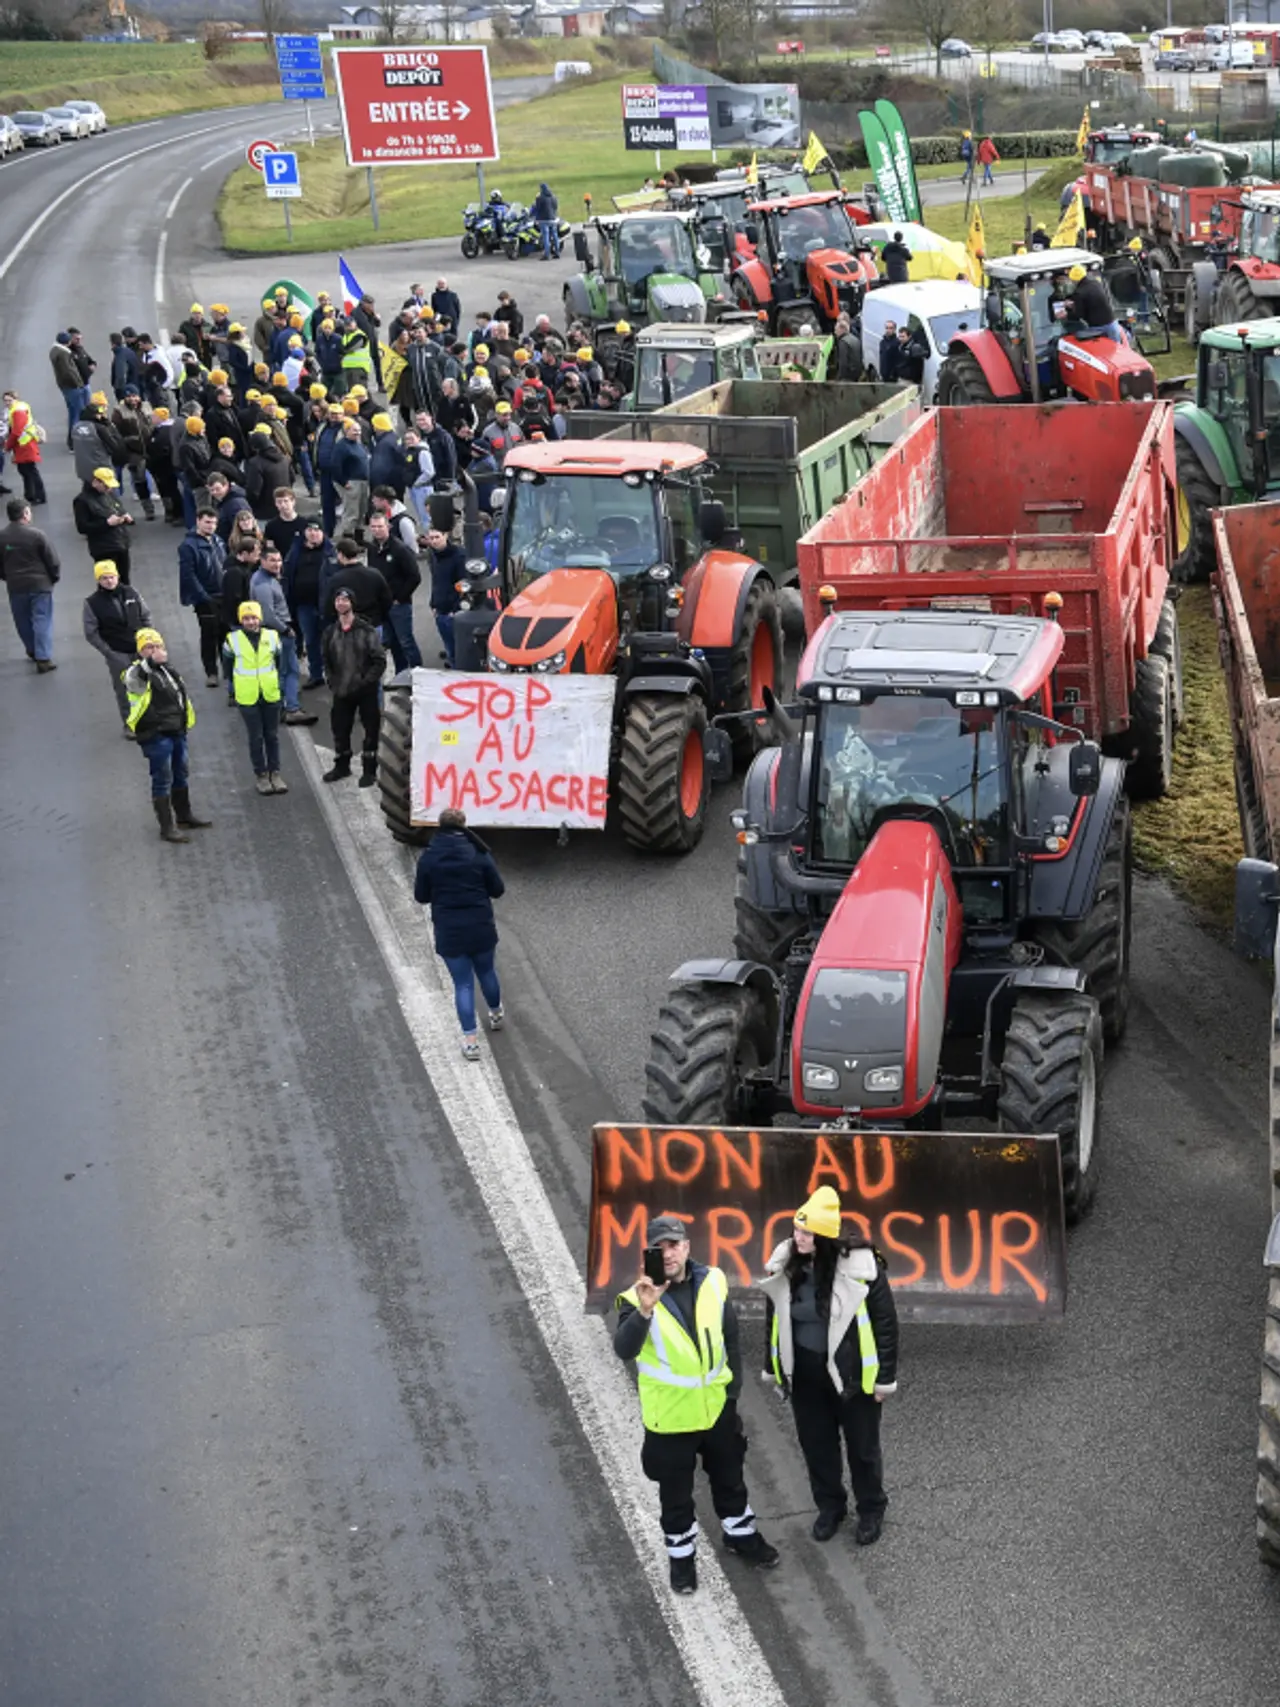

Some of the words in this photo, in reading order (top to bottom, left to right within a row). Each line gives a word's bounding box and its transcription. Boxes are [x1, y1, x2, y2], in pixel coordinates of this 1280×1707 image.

[382, 53, 439, 66] BRICO
[368, 96, 451, 123] ENTRÉE
[272, 158, 288, 180] P
[436, 677, 551, 729] STOP
[475, 722, 535, 764] AU
[424, 762, 610, 819] MASSACRE
[605, 1127, 761, 1189] NON
[807, 1134, 896, 1200] AU
[595, 1203, 1048, 1303] MRCSUR
